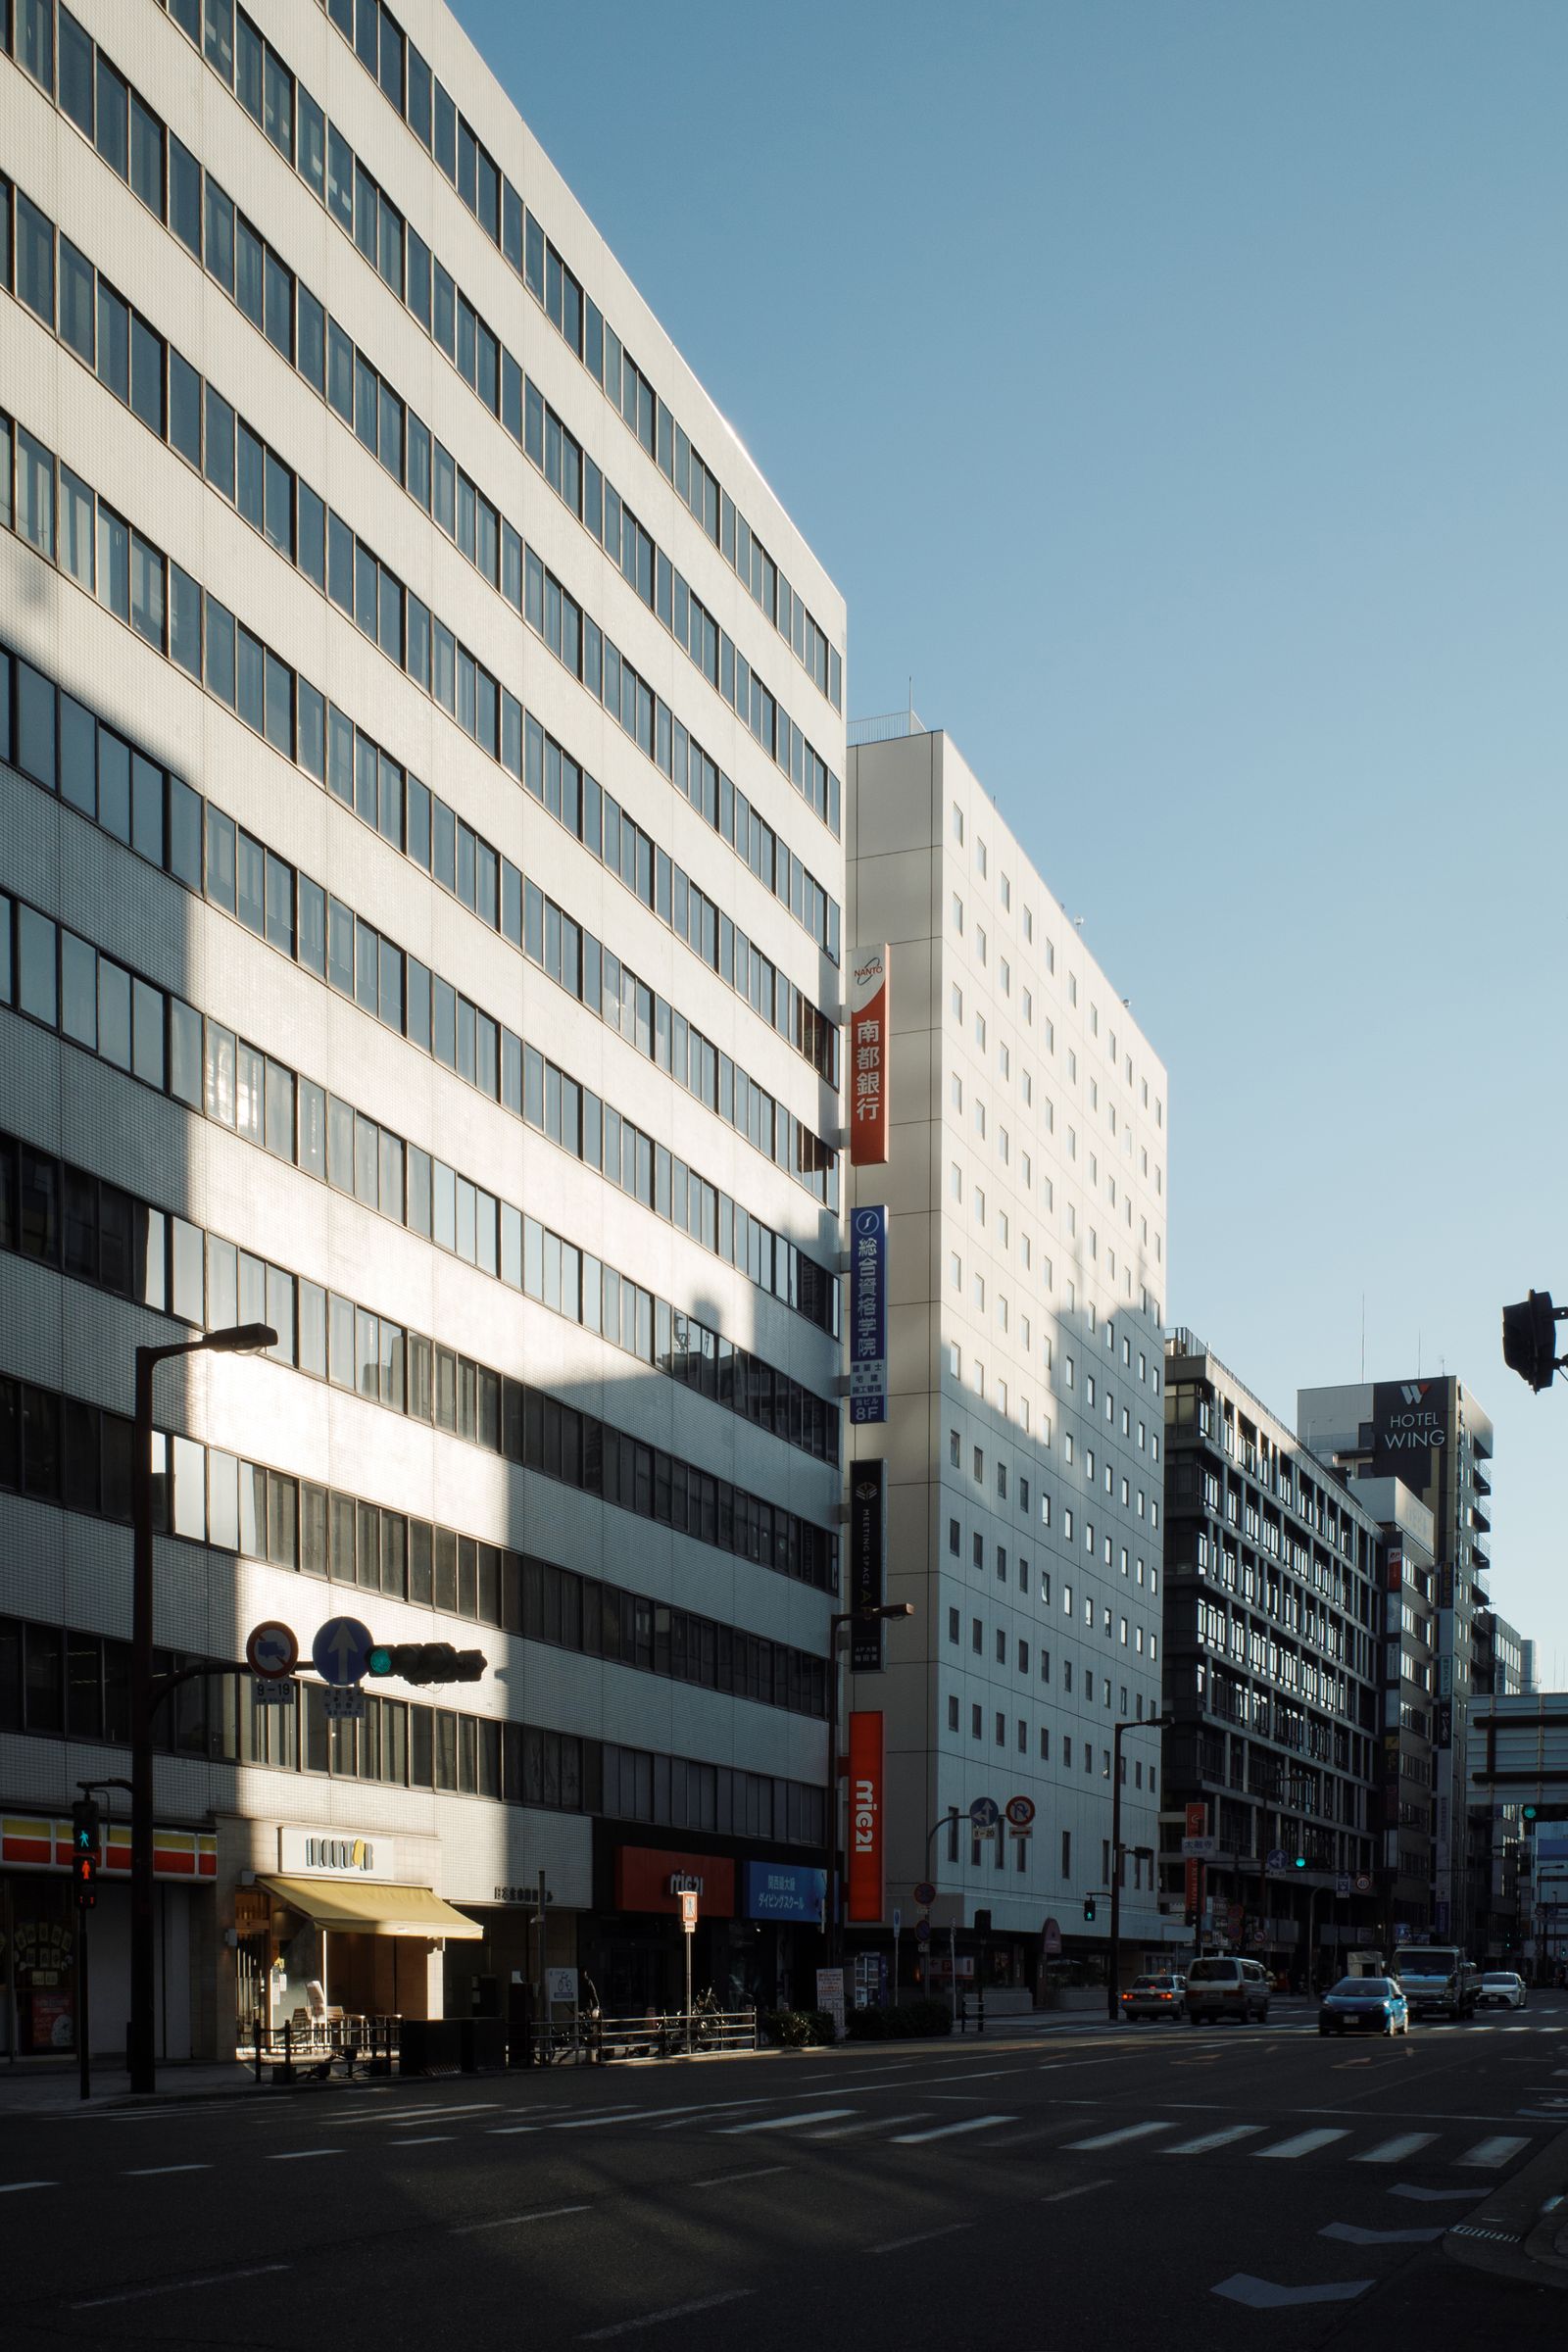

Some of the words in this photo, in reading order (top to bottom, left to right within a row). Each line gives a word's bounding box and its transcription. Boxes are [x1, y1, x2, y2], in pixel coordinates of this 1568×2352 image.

[855, 965, 883, 977] NANTO
[856, 1018, 880, 1121] 南都銀行
[858, 1237, 878, 1357] 総合資格学院
[856, 1406, 878, 1421] 8F
[1390, 1412, 1440, 1429] HOTEL
[1385, 1429, 1446, 1450] WING
[856, 1780, 876, 1853] mic21
[306, 1838, 373, 1871] DOUTOR
[759, 1891, 805, 1910] ダイビングスクール
